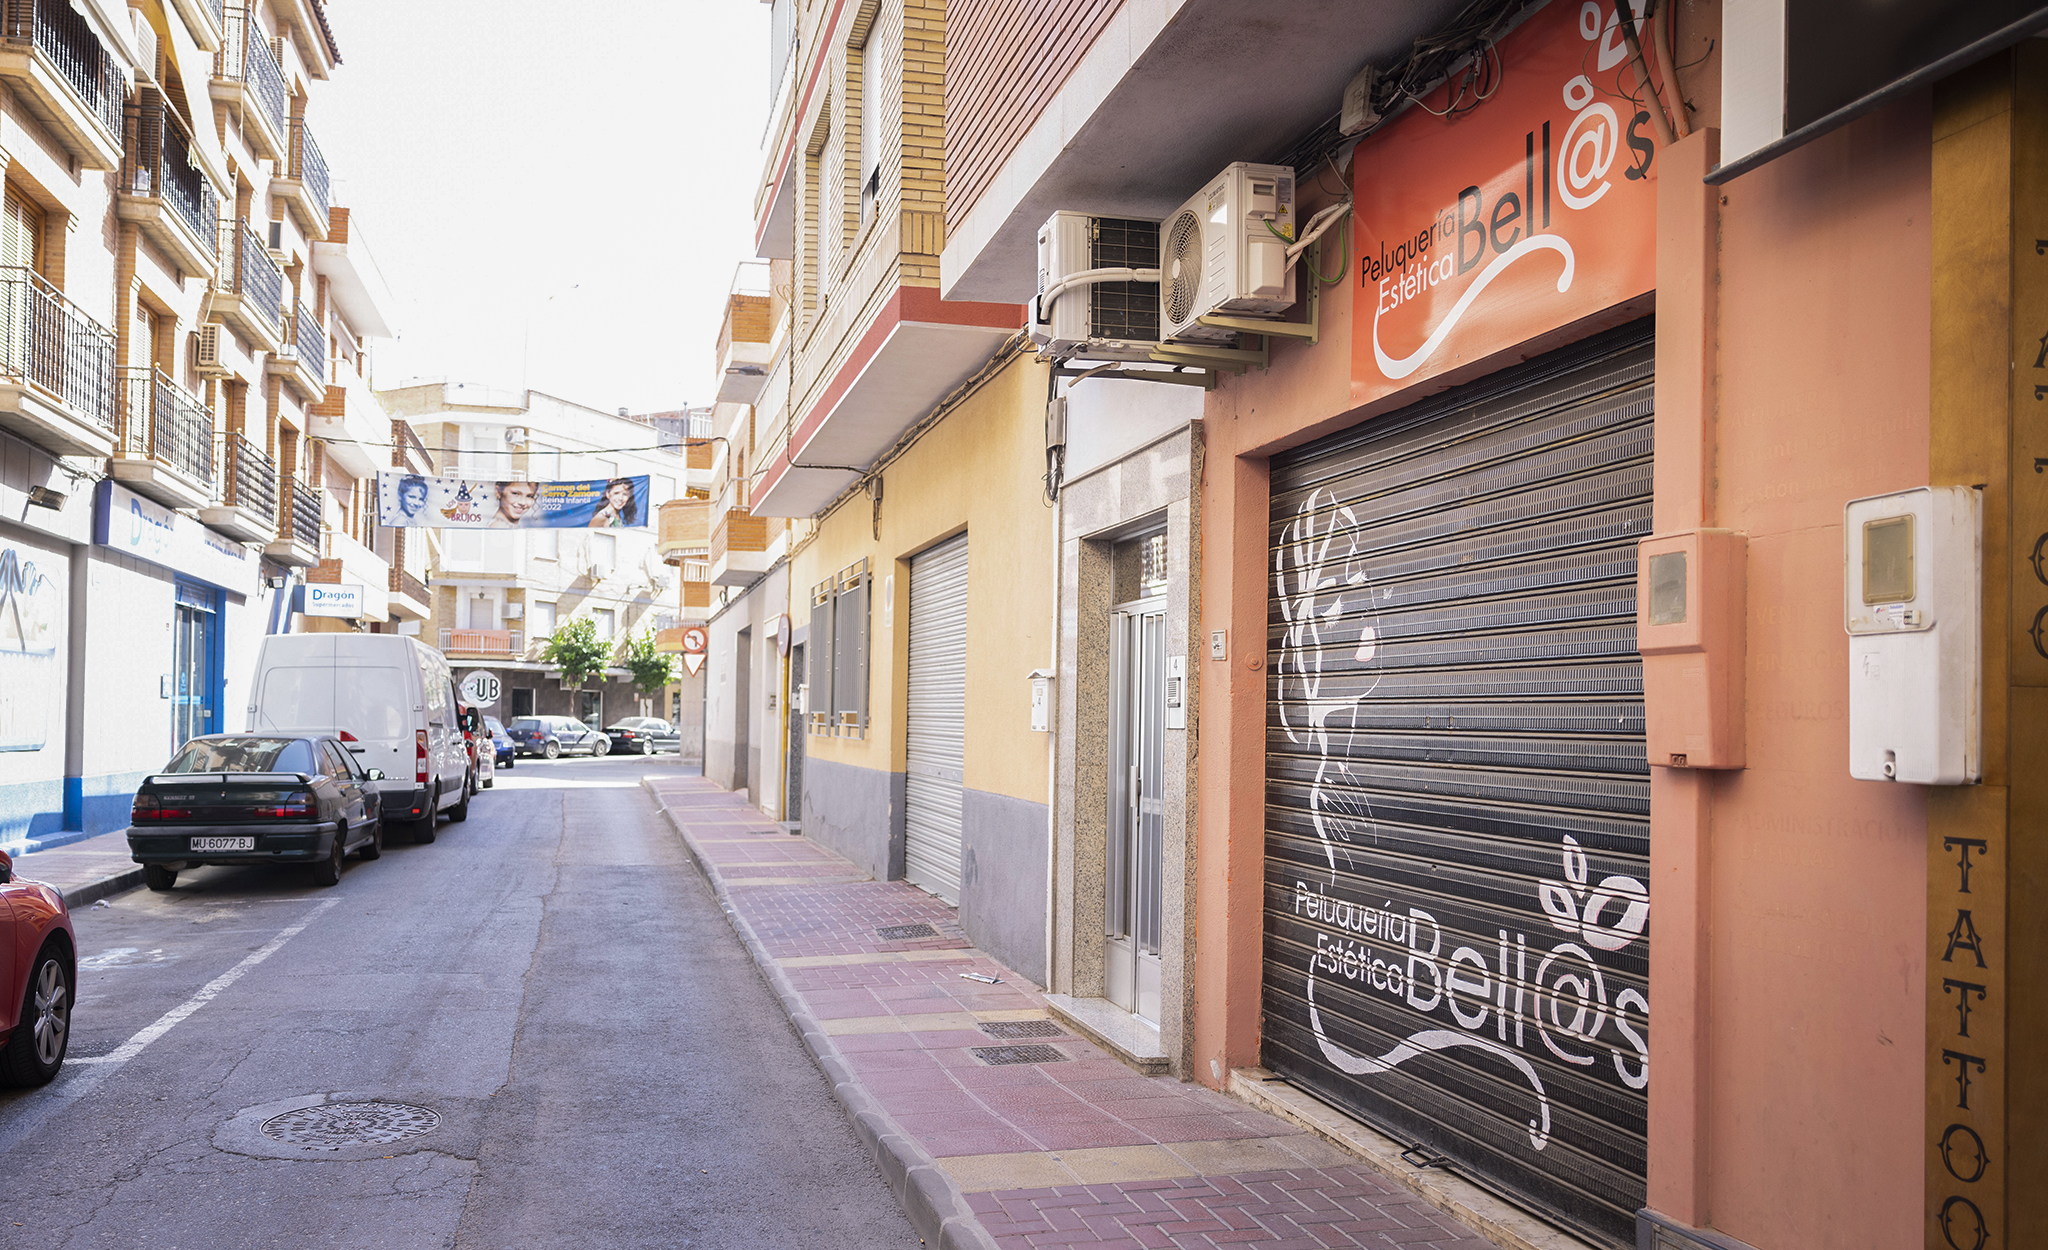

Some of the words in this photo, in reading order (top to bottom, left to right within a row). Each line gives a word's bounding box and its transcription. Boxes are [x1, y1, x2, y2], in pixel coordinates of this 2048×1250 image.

[1457, 102, 1655, 278] Bell@s
[1361, 208, 1456, 288] Peluquería
[1378, 251, 1454, 316] Estética
[446, 499, 457, 509] LOS
[451, 513, 482, 523] BRUJOS
[542, 490, 566, 498] Cerro
[567, 490, 600, 498] Zamora
[542, 503, 562, 511] 2022
[565, 496, 591, 504] Infantil
[312, 588, 355, 602] Dragón
[1294, 880, 1408, 943] Peluquería
[1316, 933, 1404, 997] Estética
[1407, 907, 1650, 1090] Bell@s
[1937, 835, 1991, 1250] TATTOO
